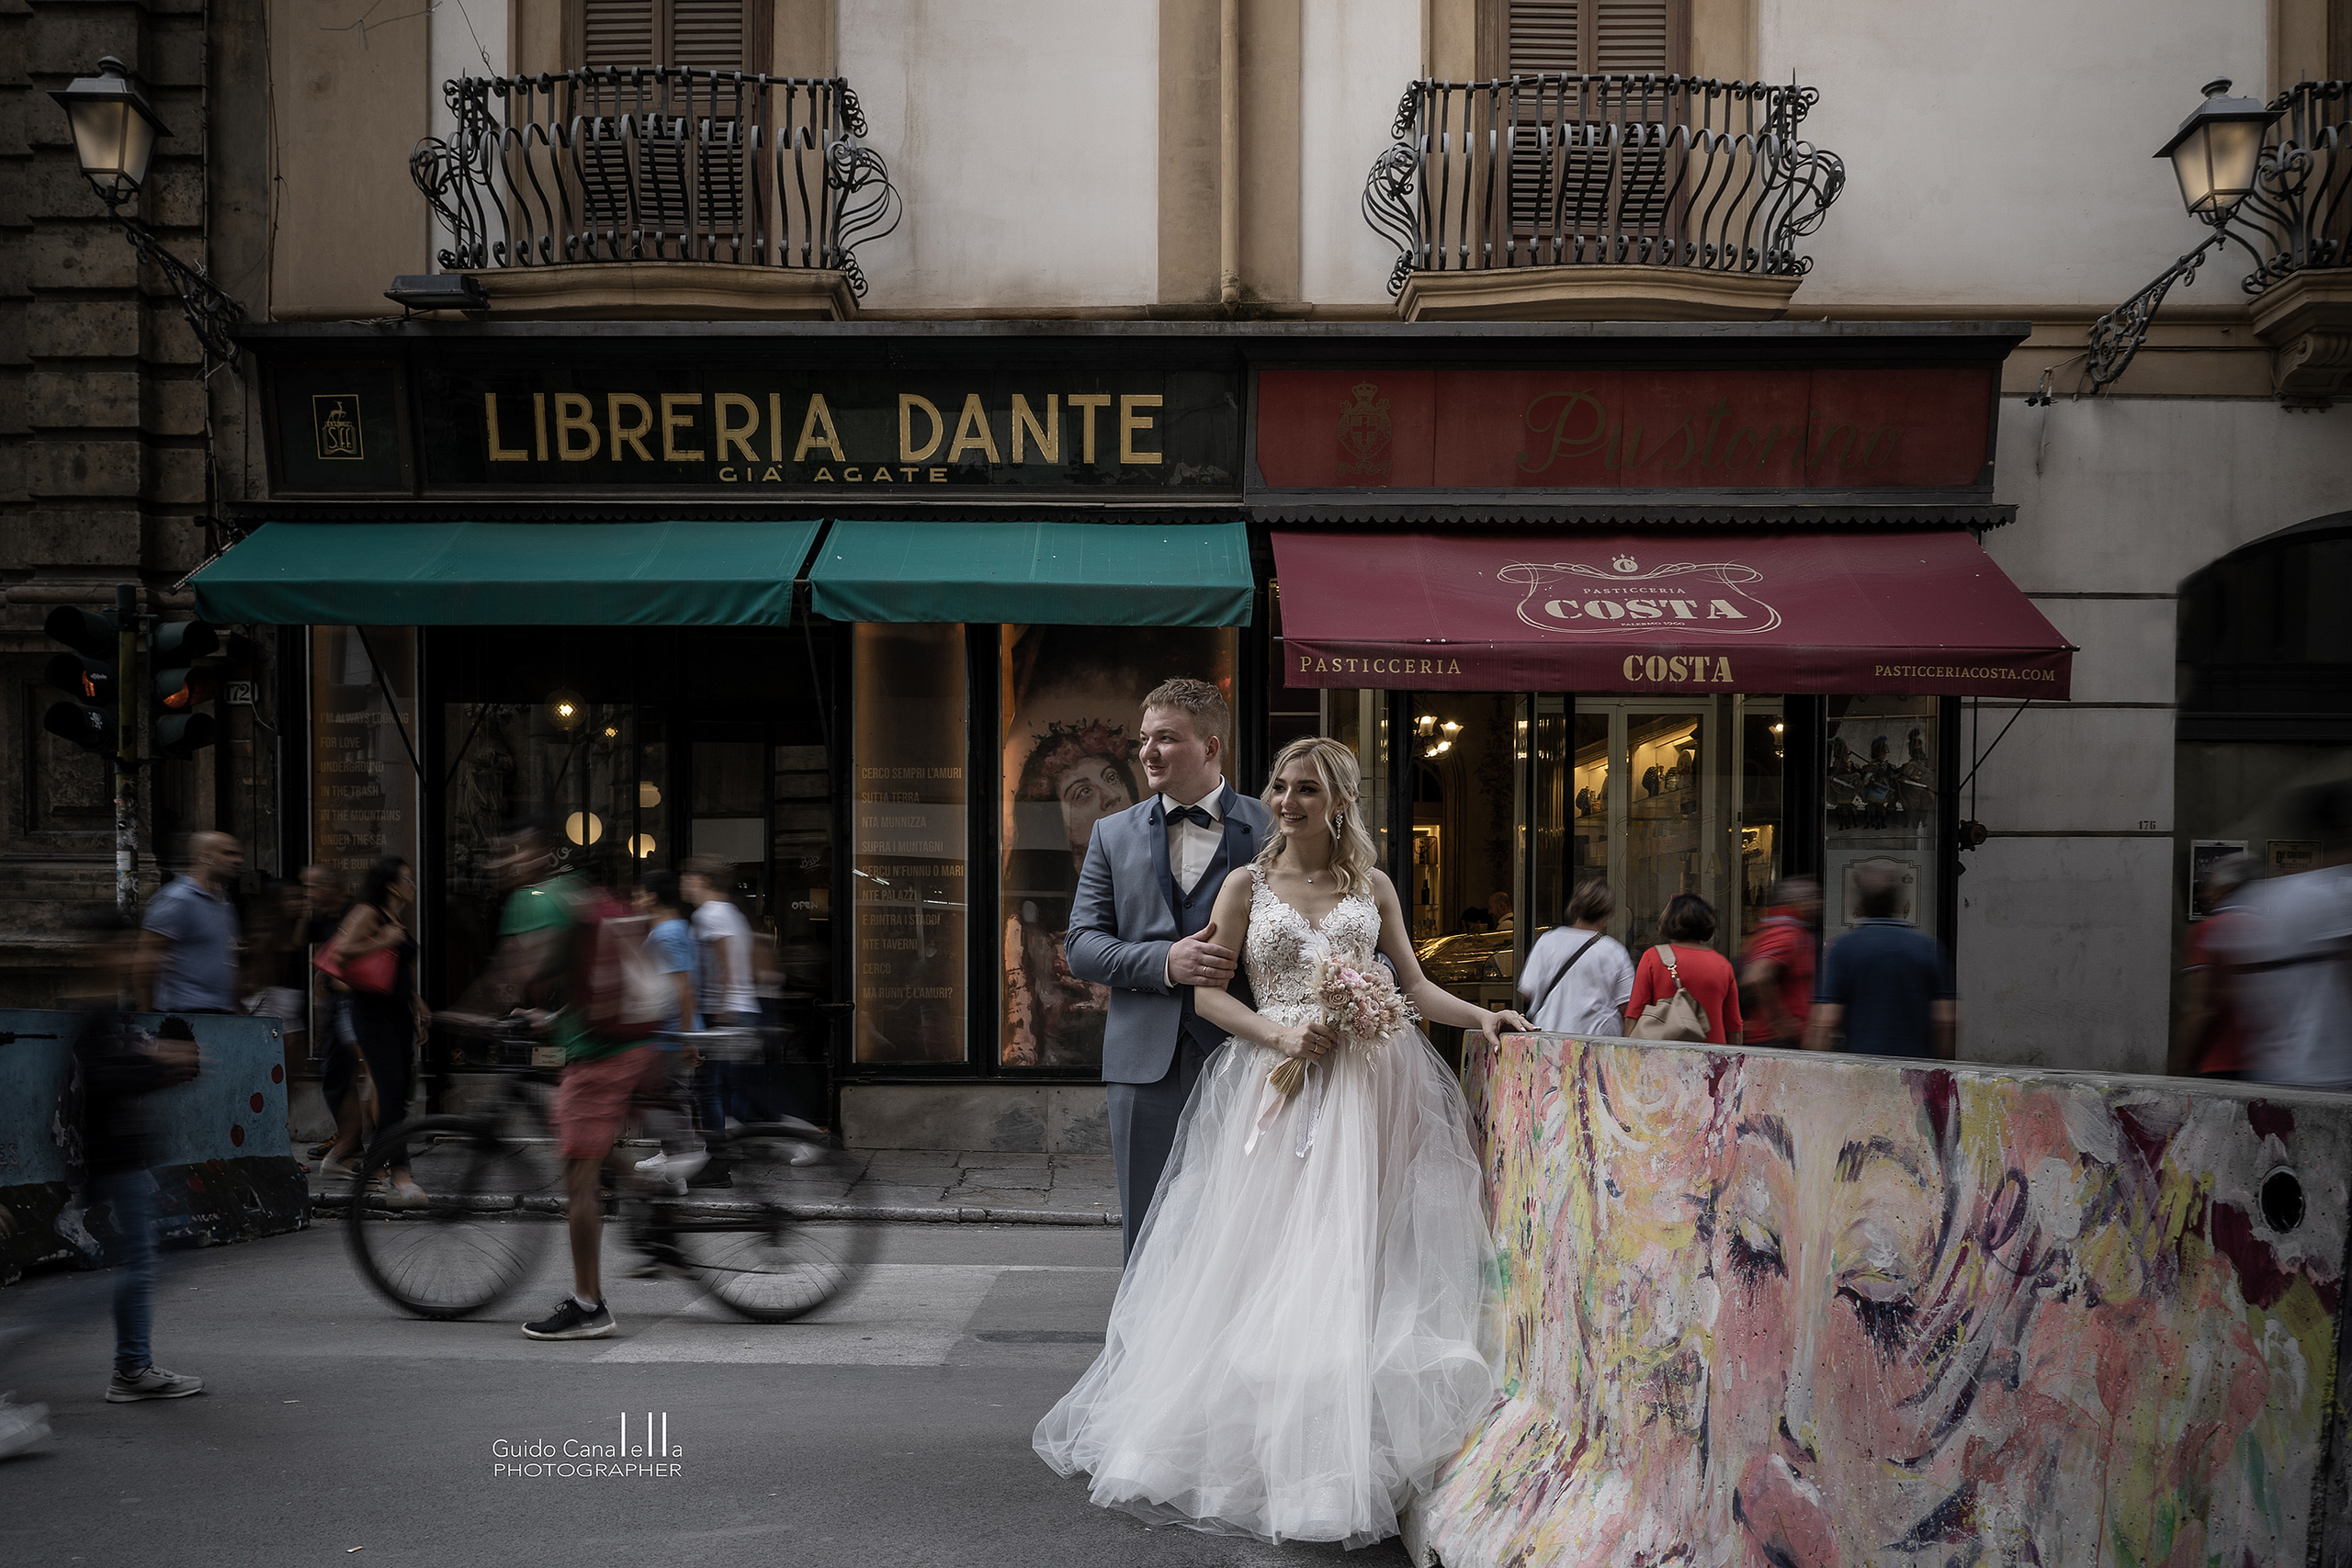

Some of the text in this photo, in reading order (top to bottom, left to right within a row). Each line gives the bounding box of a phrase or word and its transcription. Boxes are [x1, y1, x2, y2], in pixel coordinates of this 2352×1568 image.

[485, 392, 1162, 464] LIBRERIA DANTE
[1516, 388, 1905, 473] Pustorino
[719, 464, 783, 482] GIÀ
[813, 467, 947, 482] AGATE
[1544, 599, 1747, 619] COSTA
[1300, 656, 1462, 674] PASTICCERIA
[1623, 654, 1734, 682] COSTA
[1874, 664, 2056, 682] PASTICCERIACOSTA.COM
[226, 683, 250, 702] 172
[335, 712, 369, 724] ALWAYS
[320, 737, 360, 748] FOR LOVE
[320, 761, 384, 773] UNDERGROUND
[862, 767, 961, 779] CERCO SEMPRI L'AMURI
[321, 785, 379, 796] IN THE TRASH
[862, 792, 920, 804] SUTTA TERRA
[321, 809, 401, 821] IN THE MOUNTAINS
[862, 817, 926, 828] NTA MUNNIZZA
[2139, 820, 2156, 830] 176
[321, 834, 387, 845] UNDER THE SEA
[862, 840, 891, 852] SUPRA
[898, 840, 944, 852] MUNTAGNI
[332, 858, 349, 870] THE
[892, 865, 932, 876] N'FUNNU
[933, 865, 939, 876] O
[941, 865, 964, 876] MARI
[863, 889, 917, 901] NTE PALAZZI
[791, 900, 819, 910] OPEN
[863, 914, 868, 925] E
[870, 914, 902, 925] RINTRA
[863, 938, 918, 950] NTE TAVERNI
[863, 963, 891, 975] CERCO
[863, 987, 876, 998] MA
[913, 987, 953, 998] L'AMURI?
